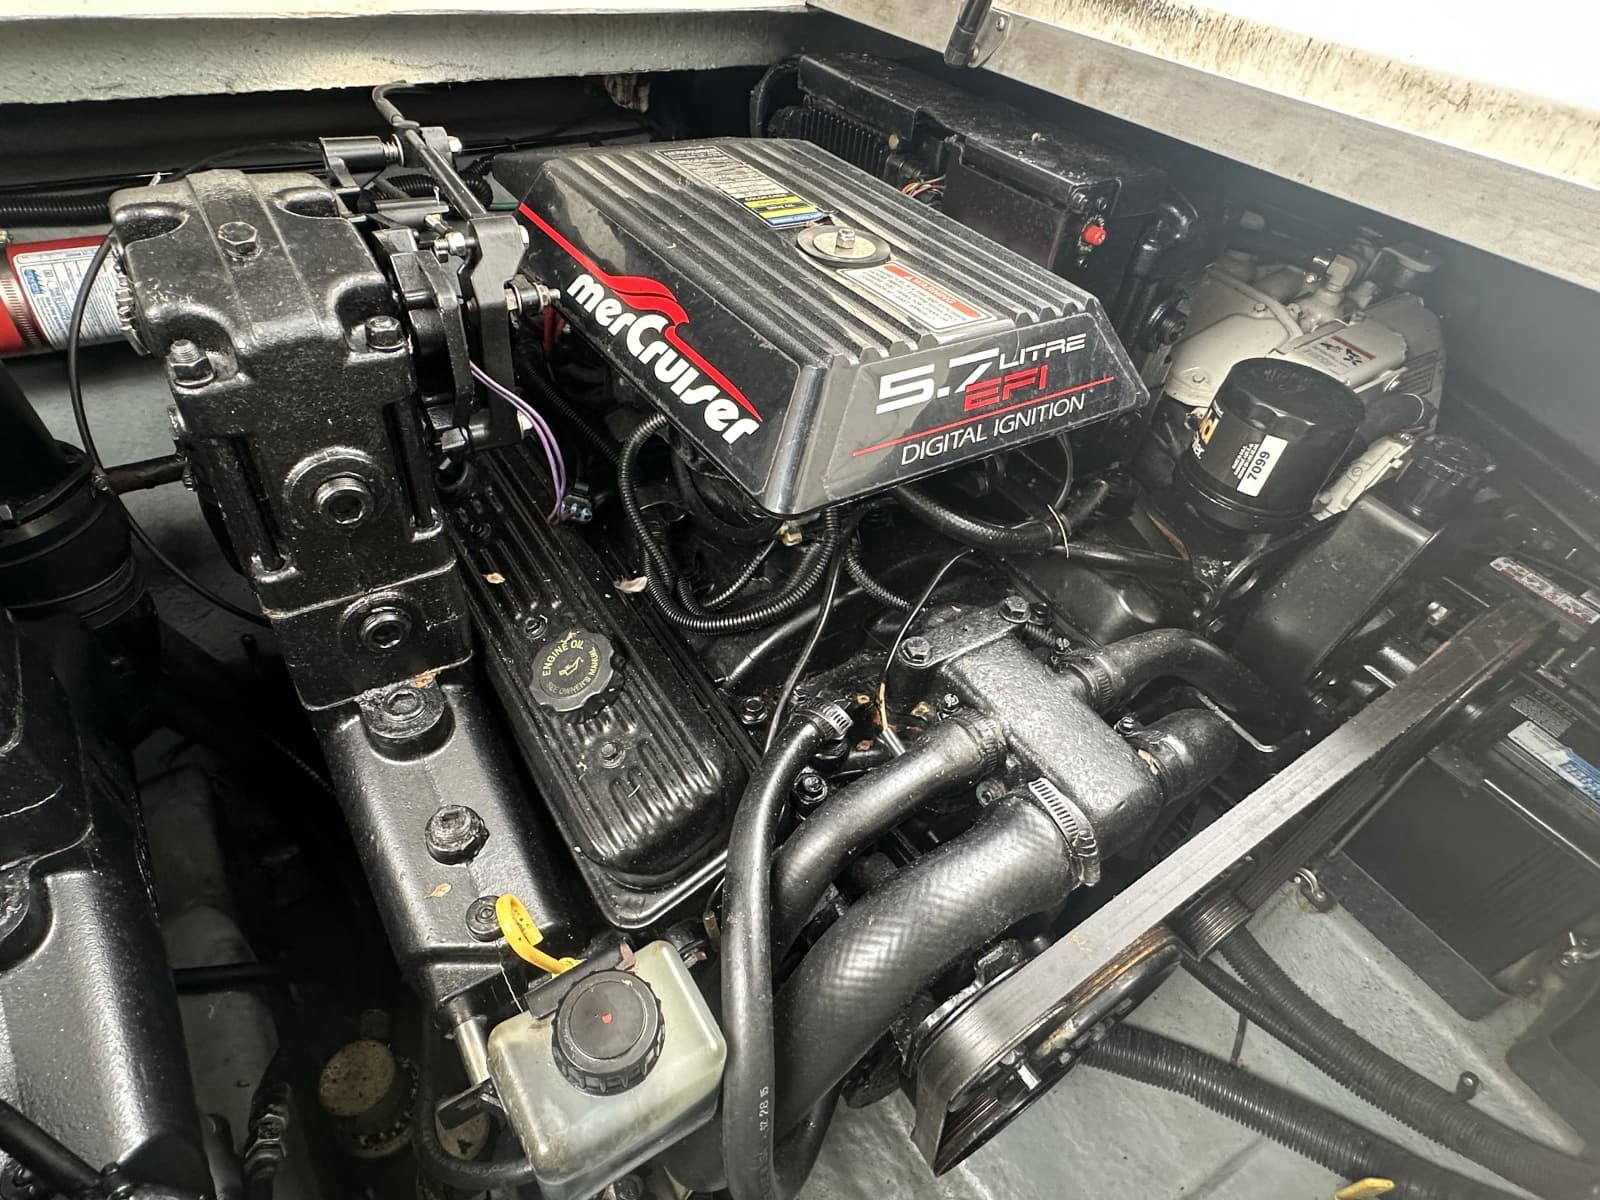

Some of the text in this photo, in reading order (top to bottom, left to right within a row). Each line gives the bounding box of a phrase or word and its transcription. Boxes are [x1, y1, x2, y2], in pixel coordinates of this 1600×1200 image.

[910, 276, 956, 305] WARNING
[875, 332, 1087, 415] 5.7 LITRE
[963, 363, 1049, 412] EFI
[901, 392, 1086, 466] DIGITAL IGNITION
[1246, 450, 1271, 481] 7099
[542, 639, 584, 677] ENGINE OIL
